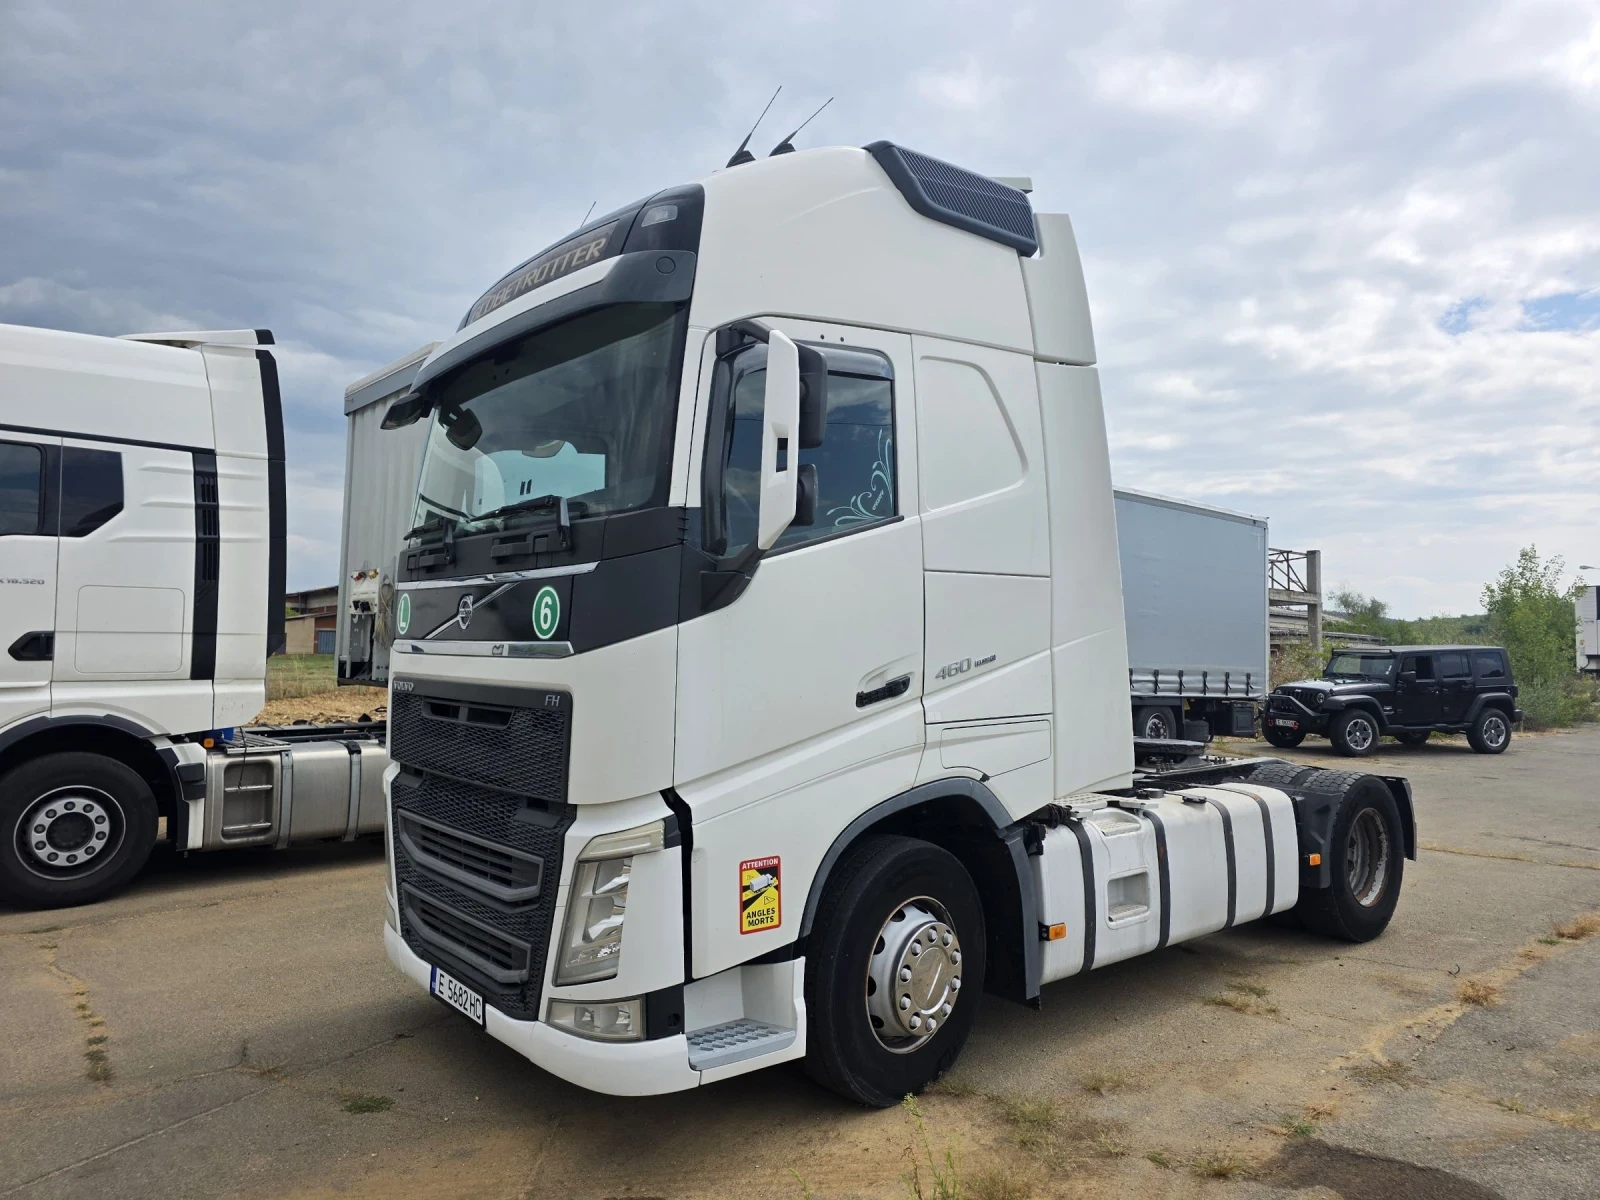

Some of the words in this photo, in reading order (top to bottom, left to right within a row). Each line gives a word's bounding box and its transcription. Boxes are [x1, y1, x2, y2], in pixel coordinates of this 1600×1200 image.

[399, 600, 407, 628] L
[540, 595, 553, 630] 6
[935, 658, 971, 679] 460
[545, 694, 560, 707] FH
[742, 858, 778, 869] ATTENTION
[747, 907, 775, 919] ANGLES
[748, 916, 774, 926] MORTS
[438, 973, 444, 995] E
